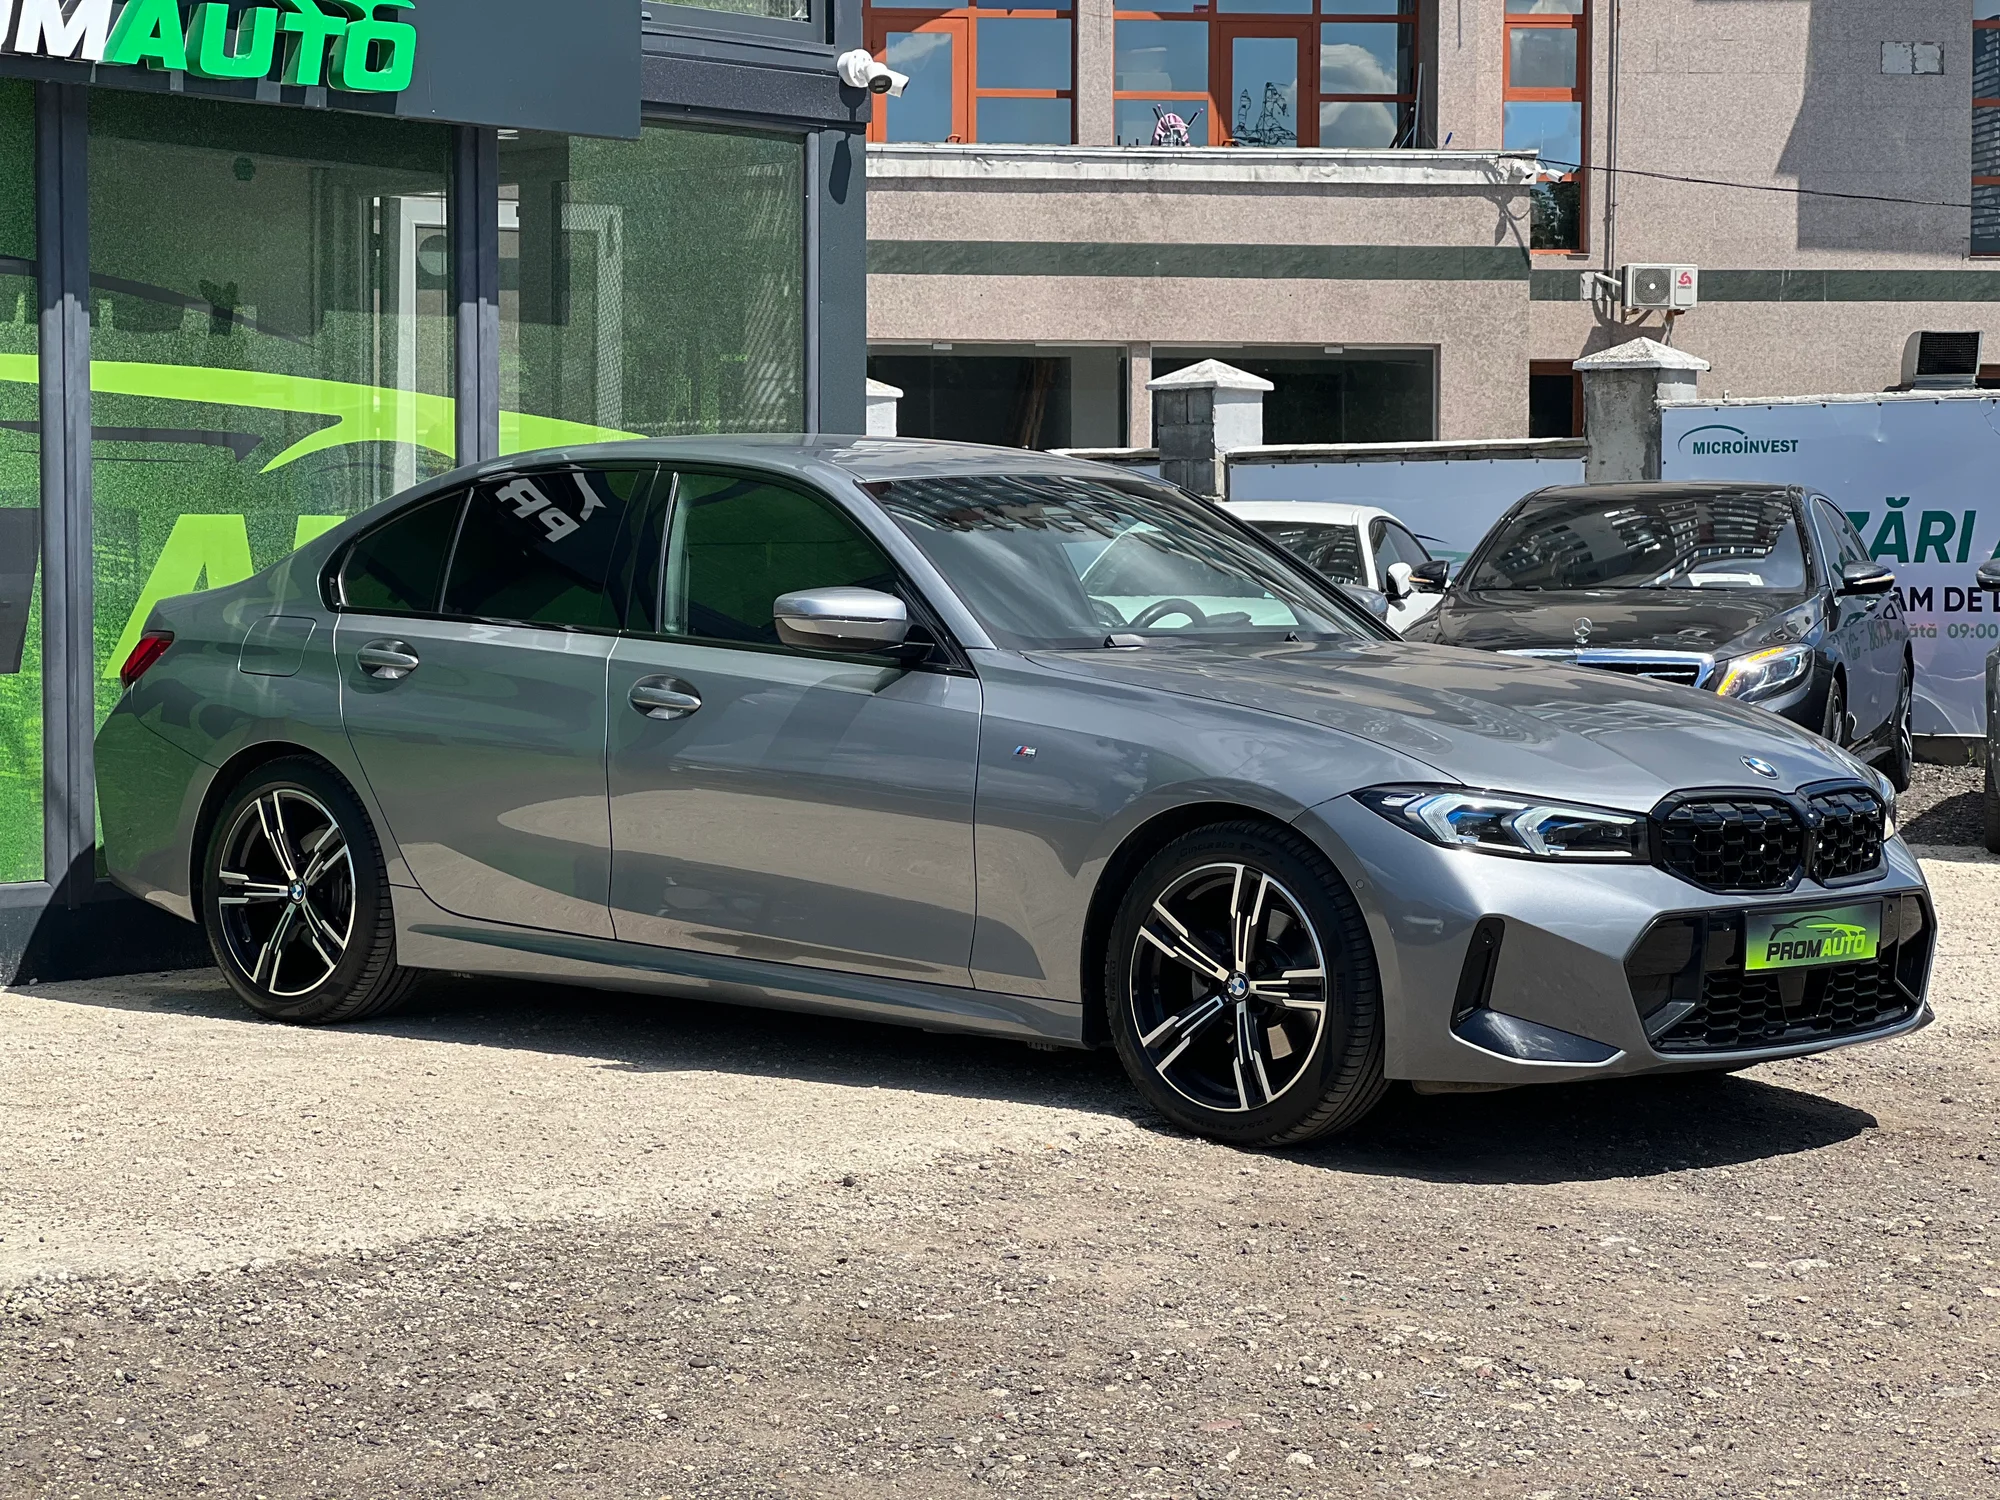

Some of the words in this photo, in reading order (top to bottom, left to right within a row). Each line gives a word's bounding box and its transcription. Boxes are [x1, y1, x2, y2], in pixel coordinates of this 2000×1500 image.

[0, 0, 417, 92] MAUTO
[1944, 587, 1982, 612] DE
[1908, 623, 1937, 638] ătă
[1947, 623, 1999, 639] 09:00
[1765, 934, 1866, 962] PROMAUTO
